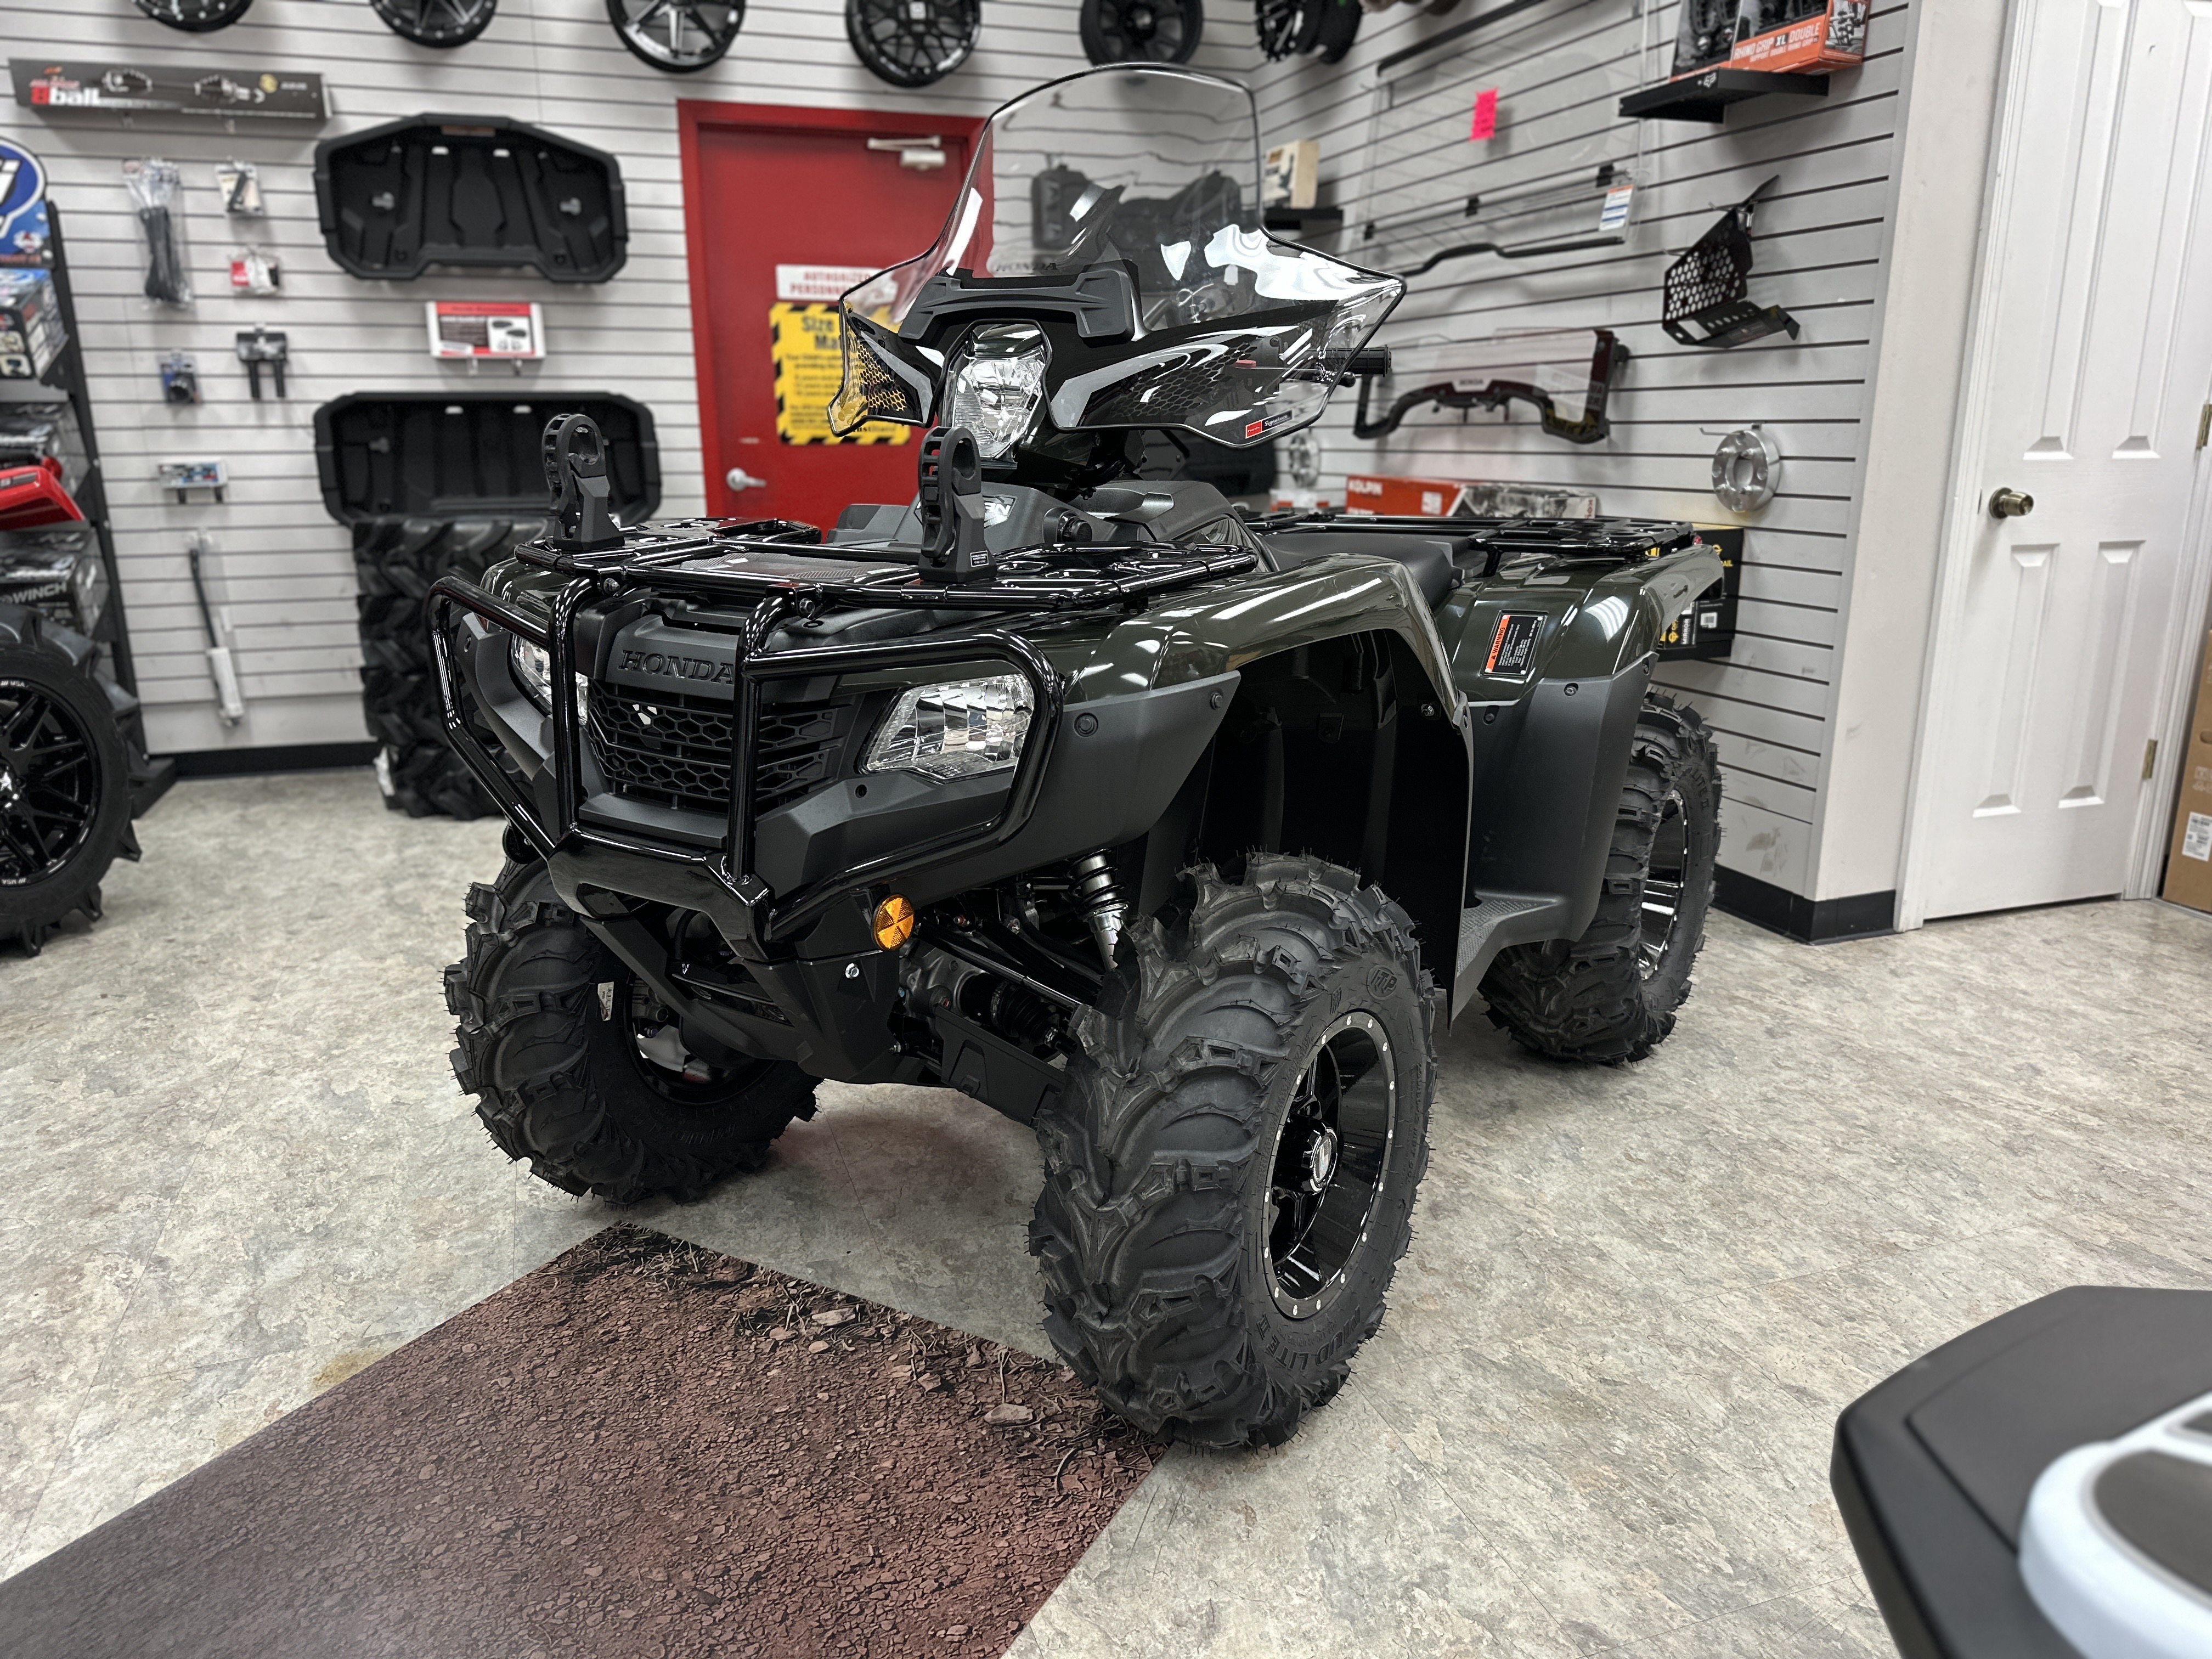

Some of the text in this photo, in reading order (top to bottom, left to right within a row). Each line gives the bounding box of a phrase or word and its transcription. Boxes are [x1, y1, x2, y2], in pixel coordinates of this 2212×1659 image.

[1734, 22, 1821, 60] RHINO GRIP XL DOUBLE
[1264, 415, 1288, 427] Signature
[12, 580, 67, 604] WINCH
[1492, 627, 1505, 653] WARNING
[1681, 618, 1690, 645] MIRROR
[618, 650, 734, 685] HONDA
[1370, 969, 1397, 991] ITP
[1316, 1304, 1361, 1365] MUD
[1266, 1335, 1310, 1371] LITE
